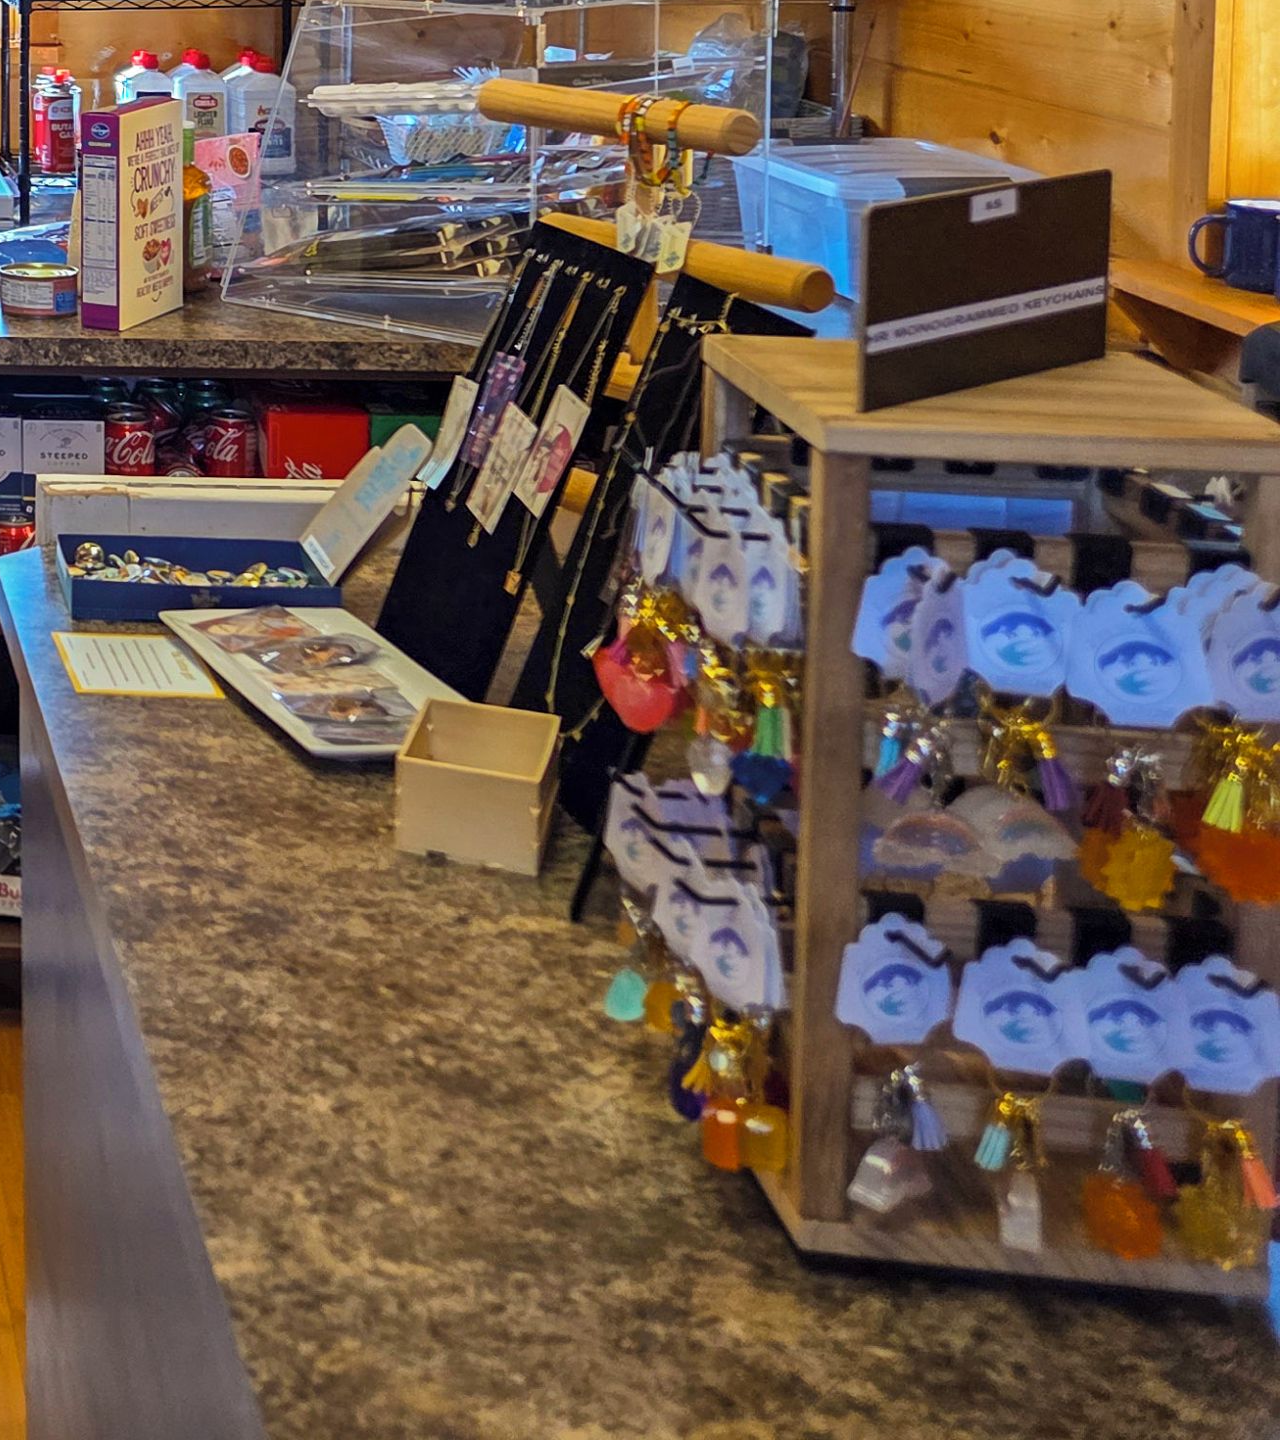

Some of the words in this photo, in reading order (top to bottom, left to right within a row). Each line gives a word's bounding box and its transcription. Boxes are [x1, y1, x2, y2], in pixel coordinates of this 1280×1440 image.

[133, 159, 176, 193] CRUNCHY
[894, 302, 1019, 338] MONOGRAMMED
[1022, 284, 1106, 312] KEYCHAINS
[40, 452, 89, 460] STEEPED
